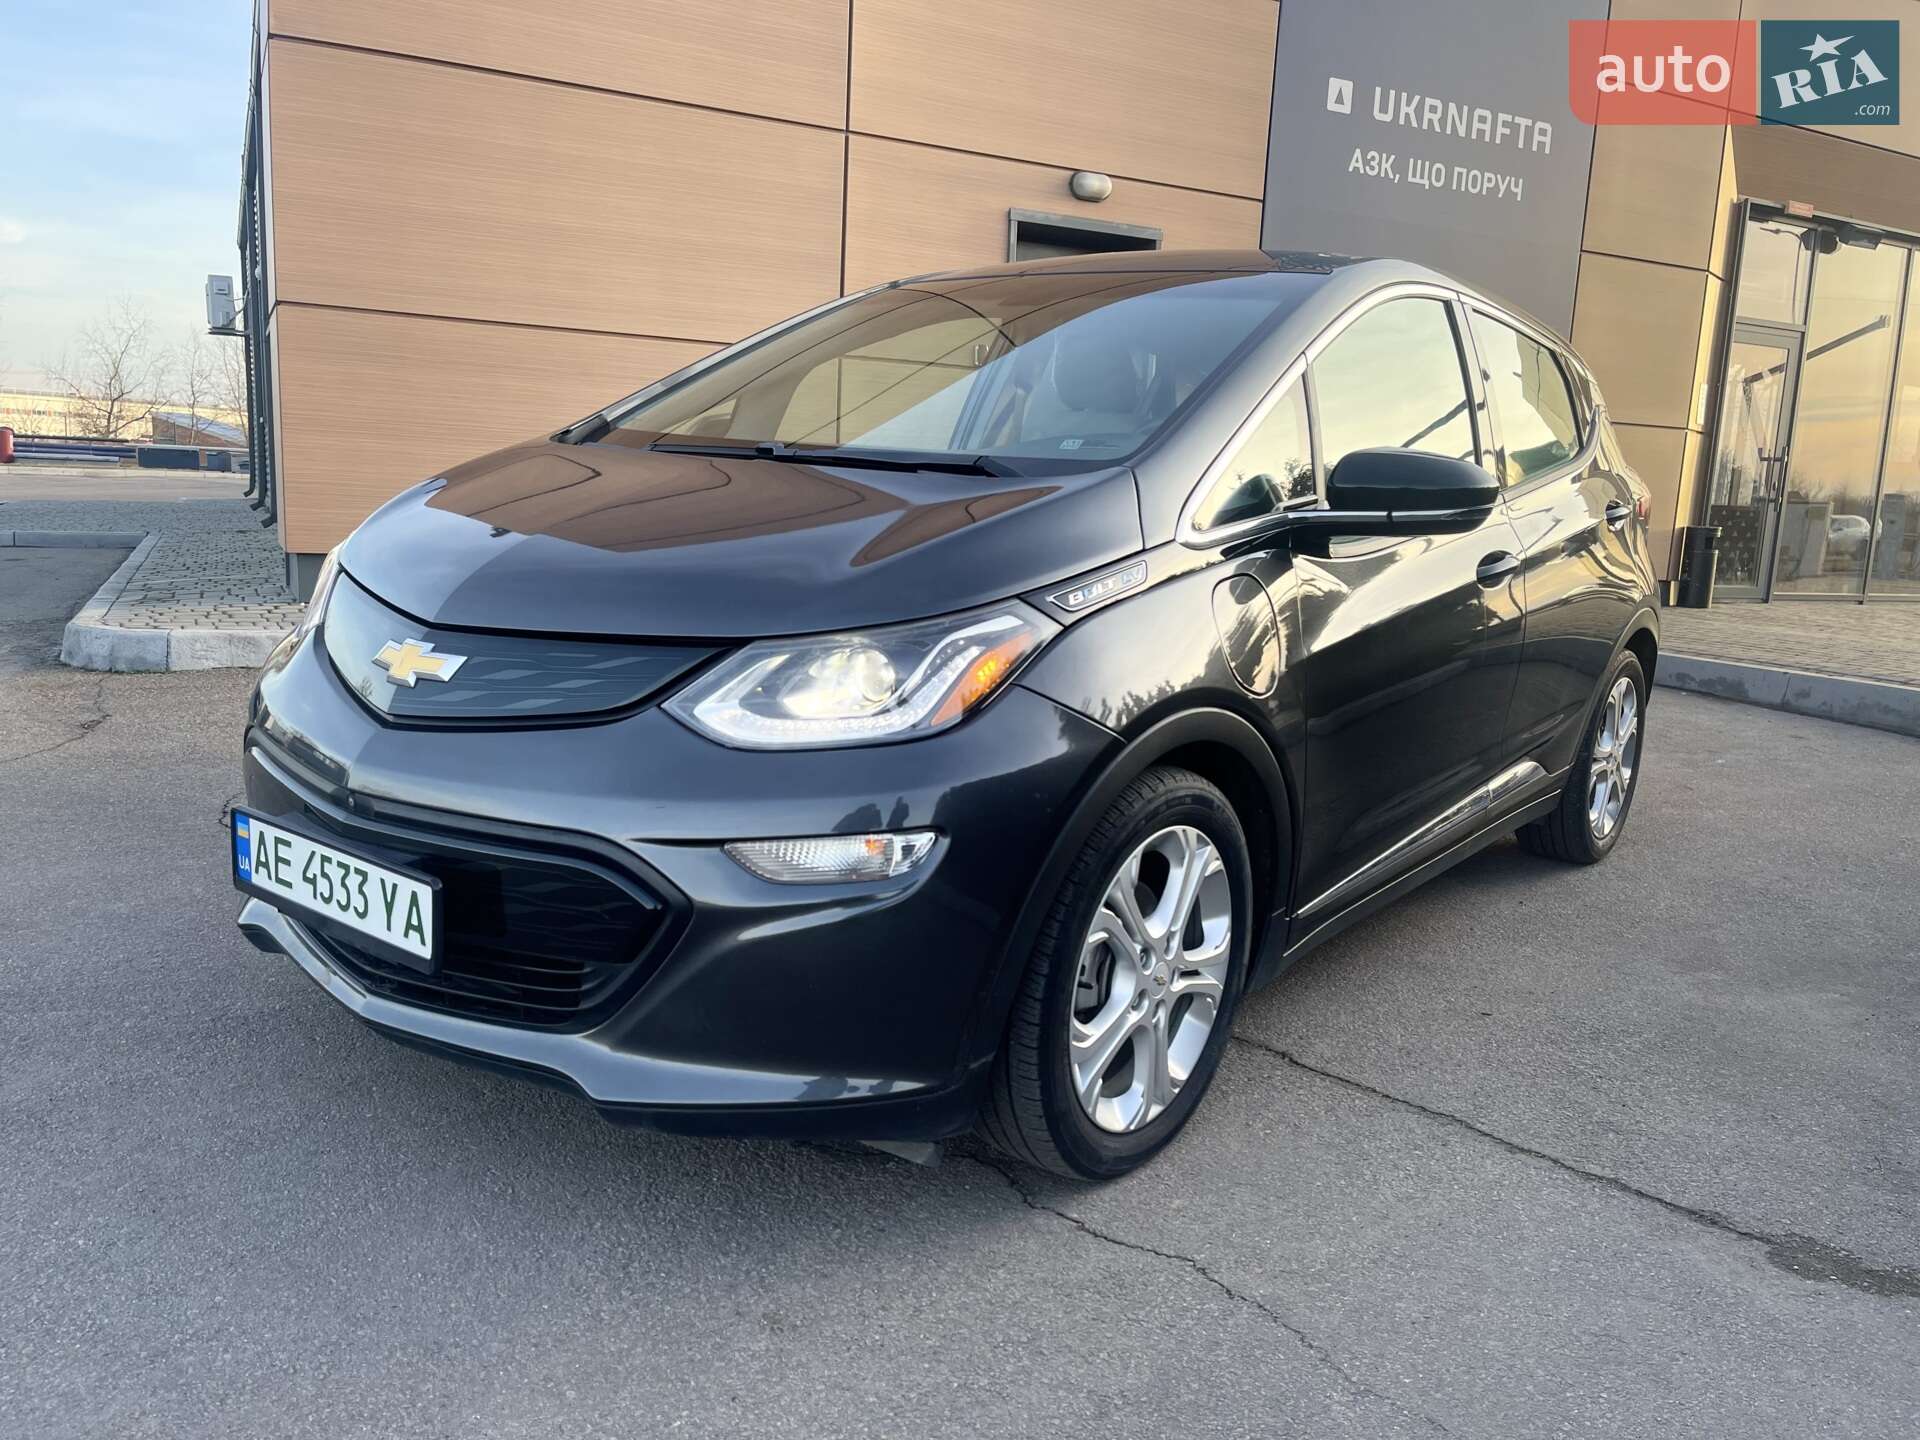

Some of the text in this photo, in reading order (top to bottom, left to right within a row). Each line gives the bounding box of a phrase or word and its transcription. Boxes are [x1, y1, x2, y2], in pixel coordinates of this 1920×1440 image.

[1373, 86, 1552, 154] UKRNAFTA
[1348, 148, 1523, 201] АЗК, ЩО ПОРУЧ
[238, 855, 251, 872] UA
[255, 830, 426, 947] AE 4533 YA
